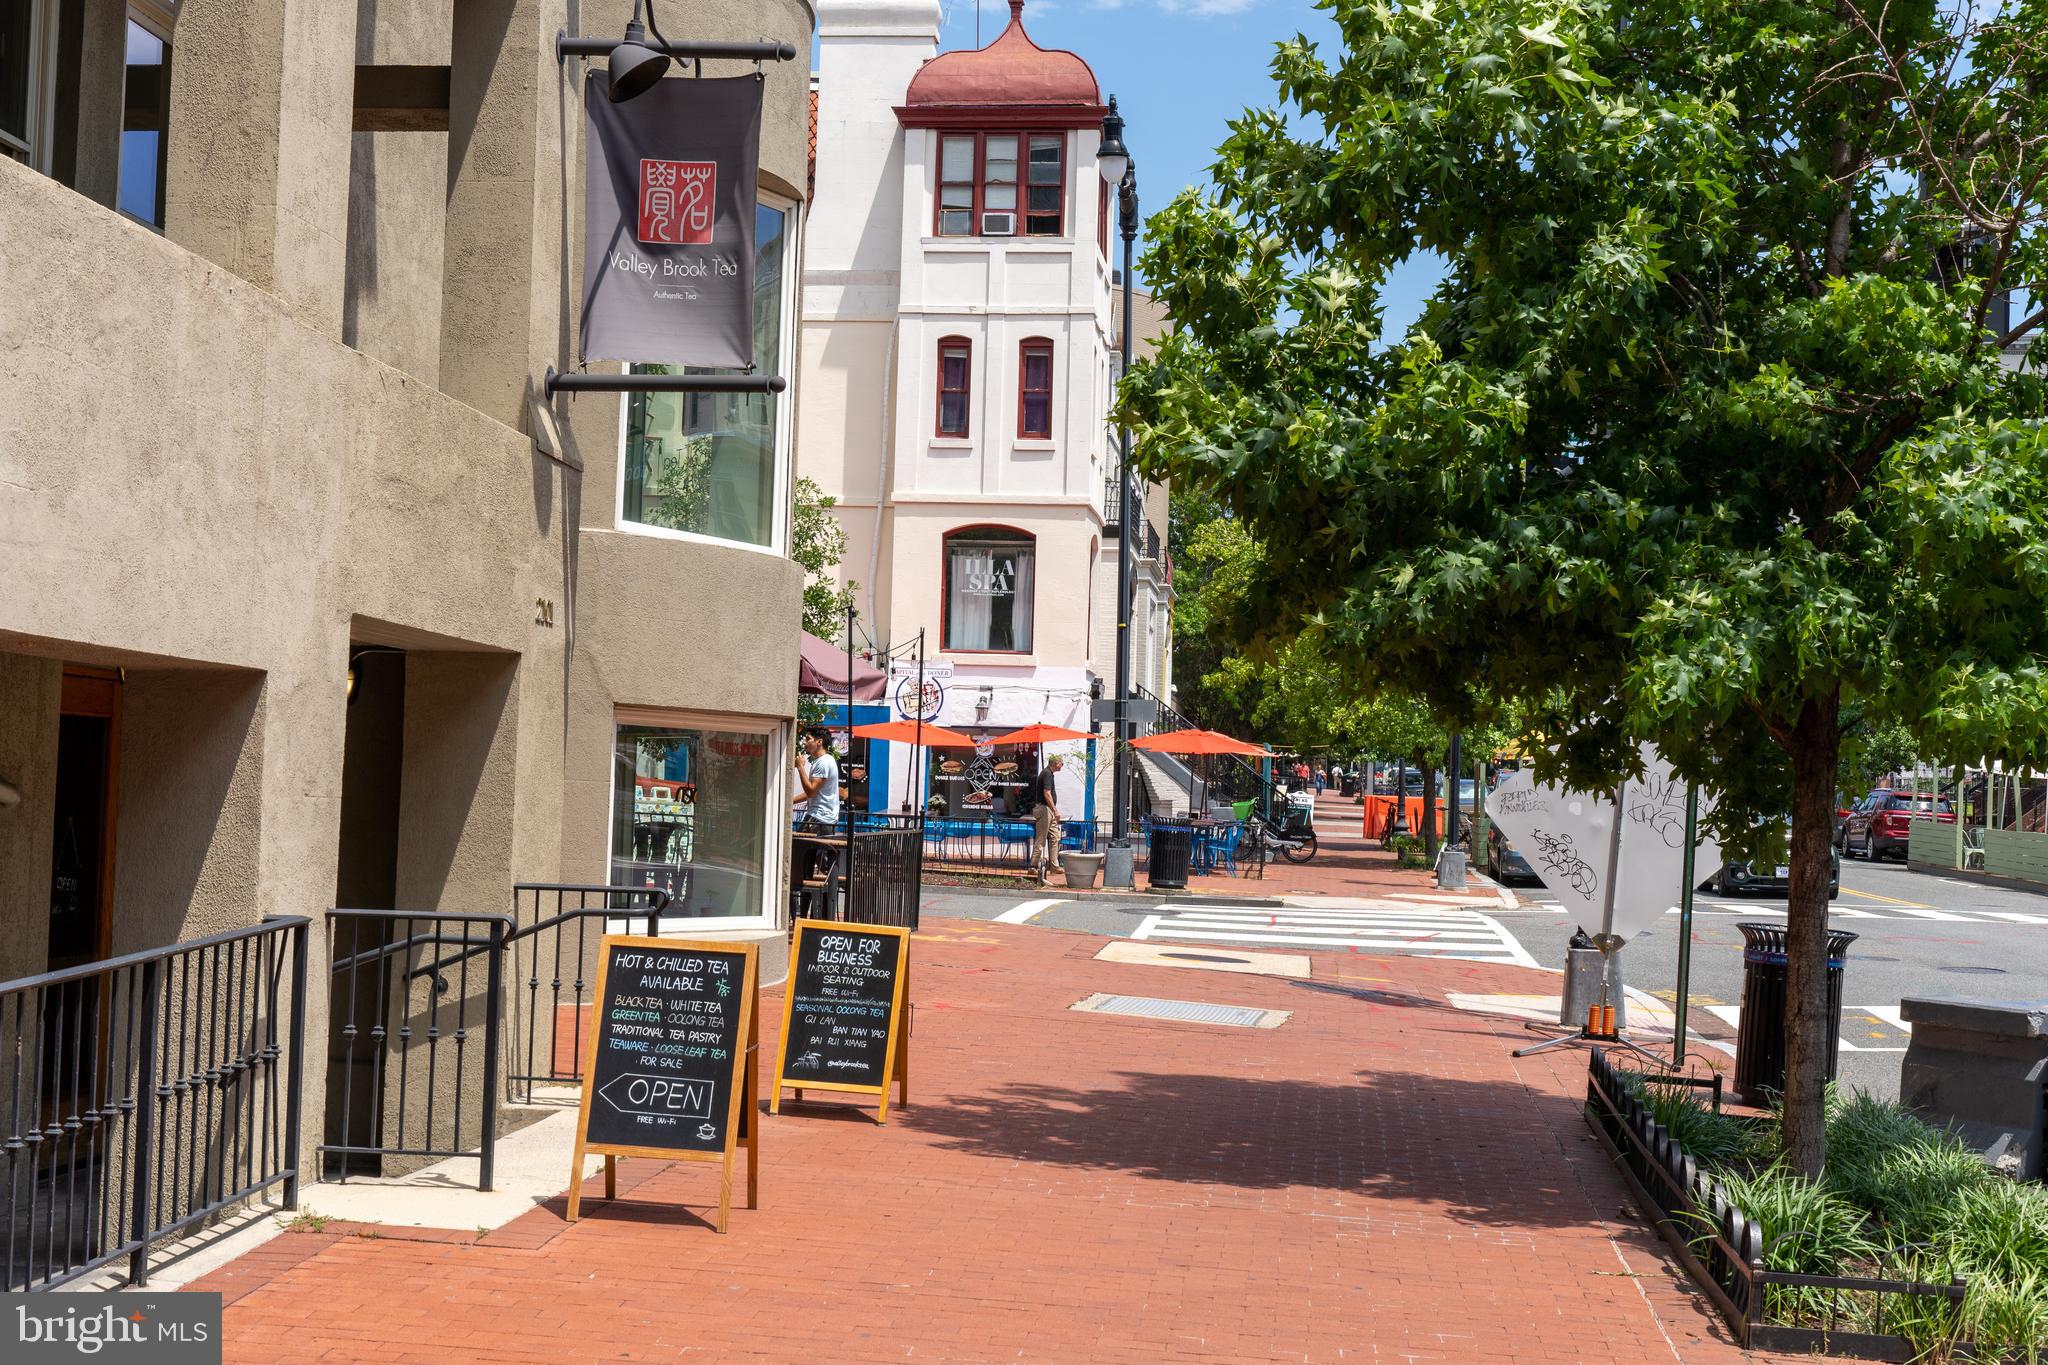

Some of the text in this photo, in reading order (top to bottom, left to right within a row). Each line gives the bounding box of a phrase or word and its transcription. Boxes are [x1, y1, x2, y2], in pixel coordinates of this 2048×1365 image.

[608, 250, 737, 280] Valley Brook Tea
[653, 290, 697, 300] Authentic Tea
[969, 574, 1009, 590] SPA
[964, 768, 997, 781] OPEN
[57, 877, 76, 891] OPEN
[820, 936, 881, 954] OPEN FOR
[615, 953, 729, 975] HOT & CHILLED TEA
[817, 950, 873, 966] BUSINESS
[807, 964, 891, 979] INDOOR & OUTDOOR
[640, 975, 704, 991] AVAILABLE
[822, 975, 865, 987] SEATING
[821, 987, 838, 996] FREE
[615, 994, 722, 1014] BLACK TEA WHITE TEA
[795, 1003, 885, 1019] SEASONAL OOLONG TEA
[611, 1009, 725, 1029] GREEN TEA OOLONG TEA
[804, 1014, 837, 1025] QI LAN
[611, 1024, 722, 1044] TRADITIONAL TEA PASTRY
[832, 1025, 886, 1039] BAN TIAN YAO
[609, 1038, 727, 1060] TEAWARE LOOSE LEAF TEA
[810, 1036, 823, 1045] BAI
[844, 1039, 868, 1049] XIANG
[640, 1056, 683, 1069] FOR SALE
[628, 1079, 704, 1110] OPEN
[636, 1116, 654, 1124] FREE
